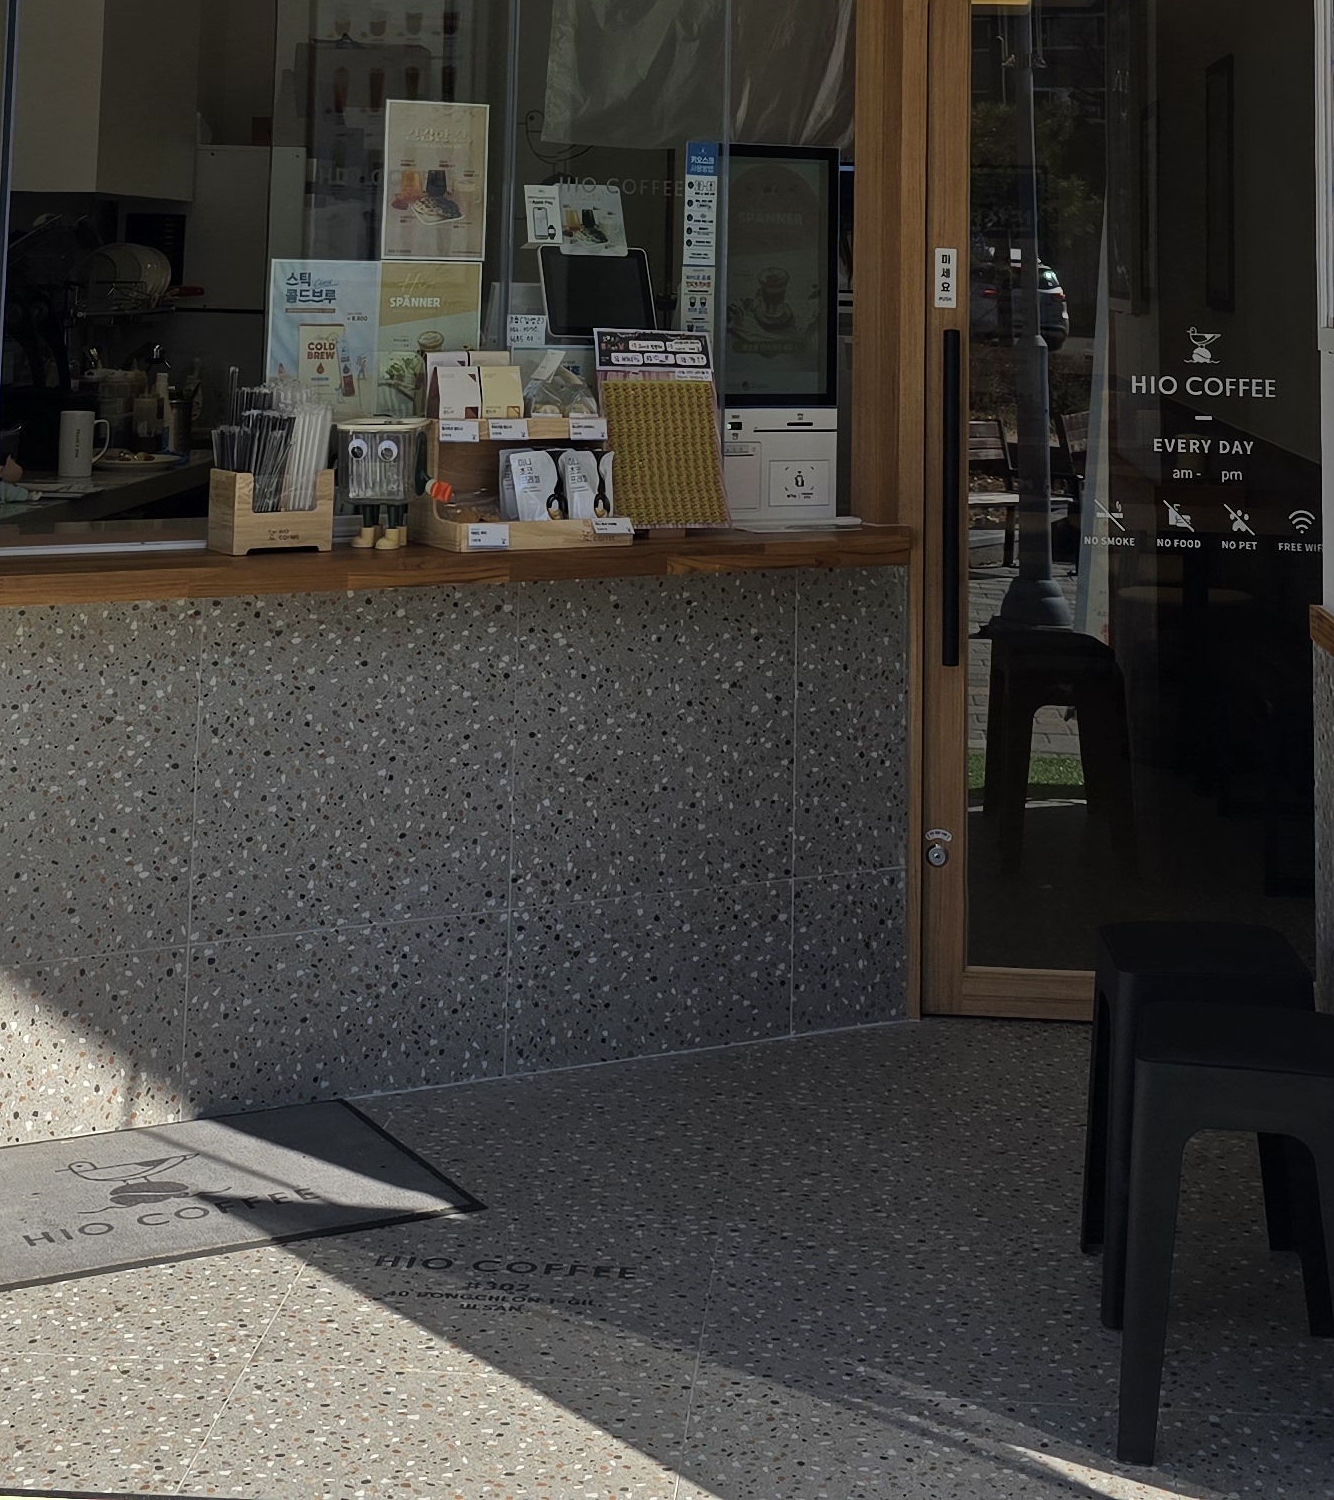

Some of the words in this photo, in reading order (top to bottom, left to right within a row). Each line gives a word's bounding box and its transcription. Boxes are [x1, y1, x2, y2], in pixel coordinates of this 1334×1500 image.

[941, 255, 950, 292] 미세요
[308, 342, 335, 351] COLD
[307, 351, 335, 360] BREW
[1131, 375, 1178, 396] HIO
[1185, 376, 1277, 399] COFFEE
[1153, 438, 1212, 454] EVERY
[1219, 440, 1254, 456] DAY
[1221, 469, 1243, 483] pm
[1084, 536, 1099, 546] NO
[1101, 536, 1135, 547] SMOKE
[1156, 538, 1171, 548] NO
[1174, 539, 1201, 549] FOOD
[1221, 541, 1236, 550] NO
[1238, 541, 1258, 551] PET
[1278, 543, 1302, 551] FREE
[1305, 543, 1323, 552] WIF
[21, 1219, 118, 1248] HIO
[135, 1185, 322, 1228] COFFEE
[374, 1255, 454, 1270] HIO
[472, 1259, 638, 1280] COFFEE
